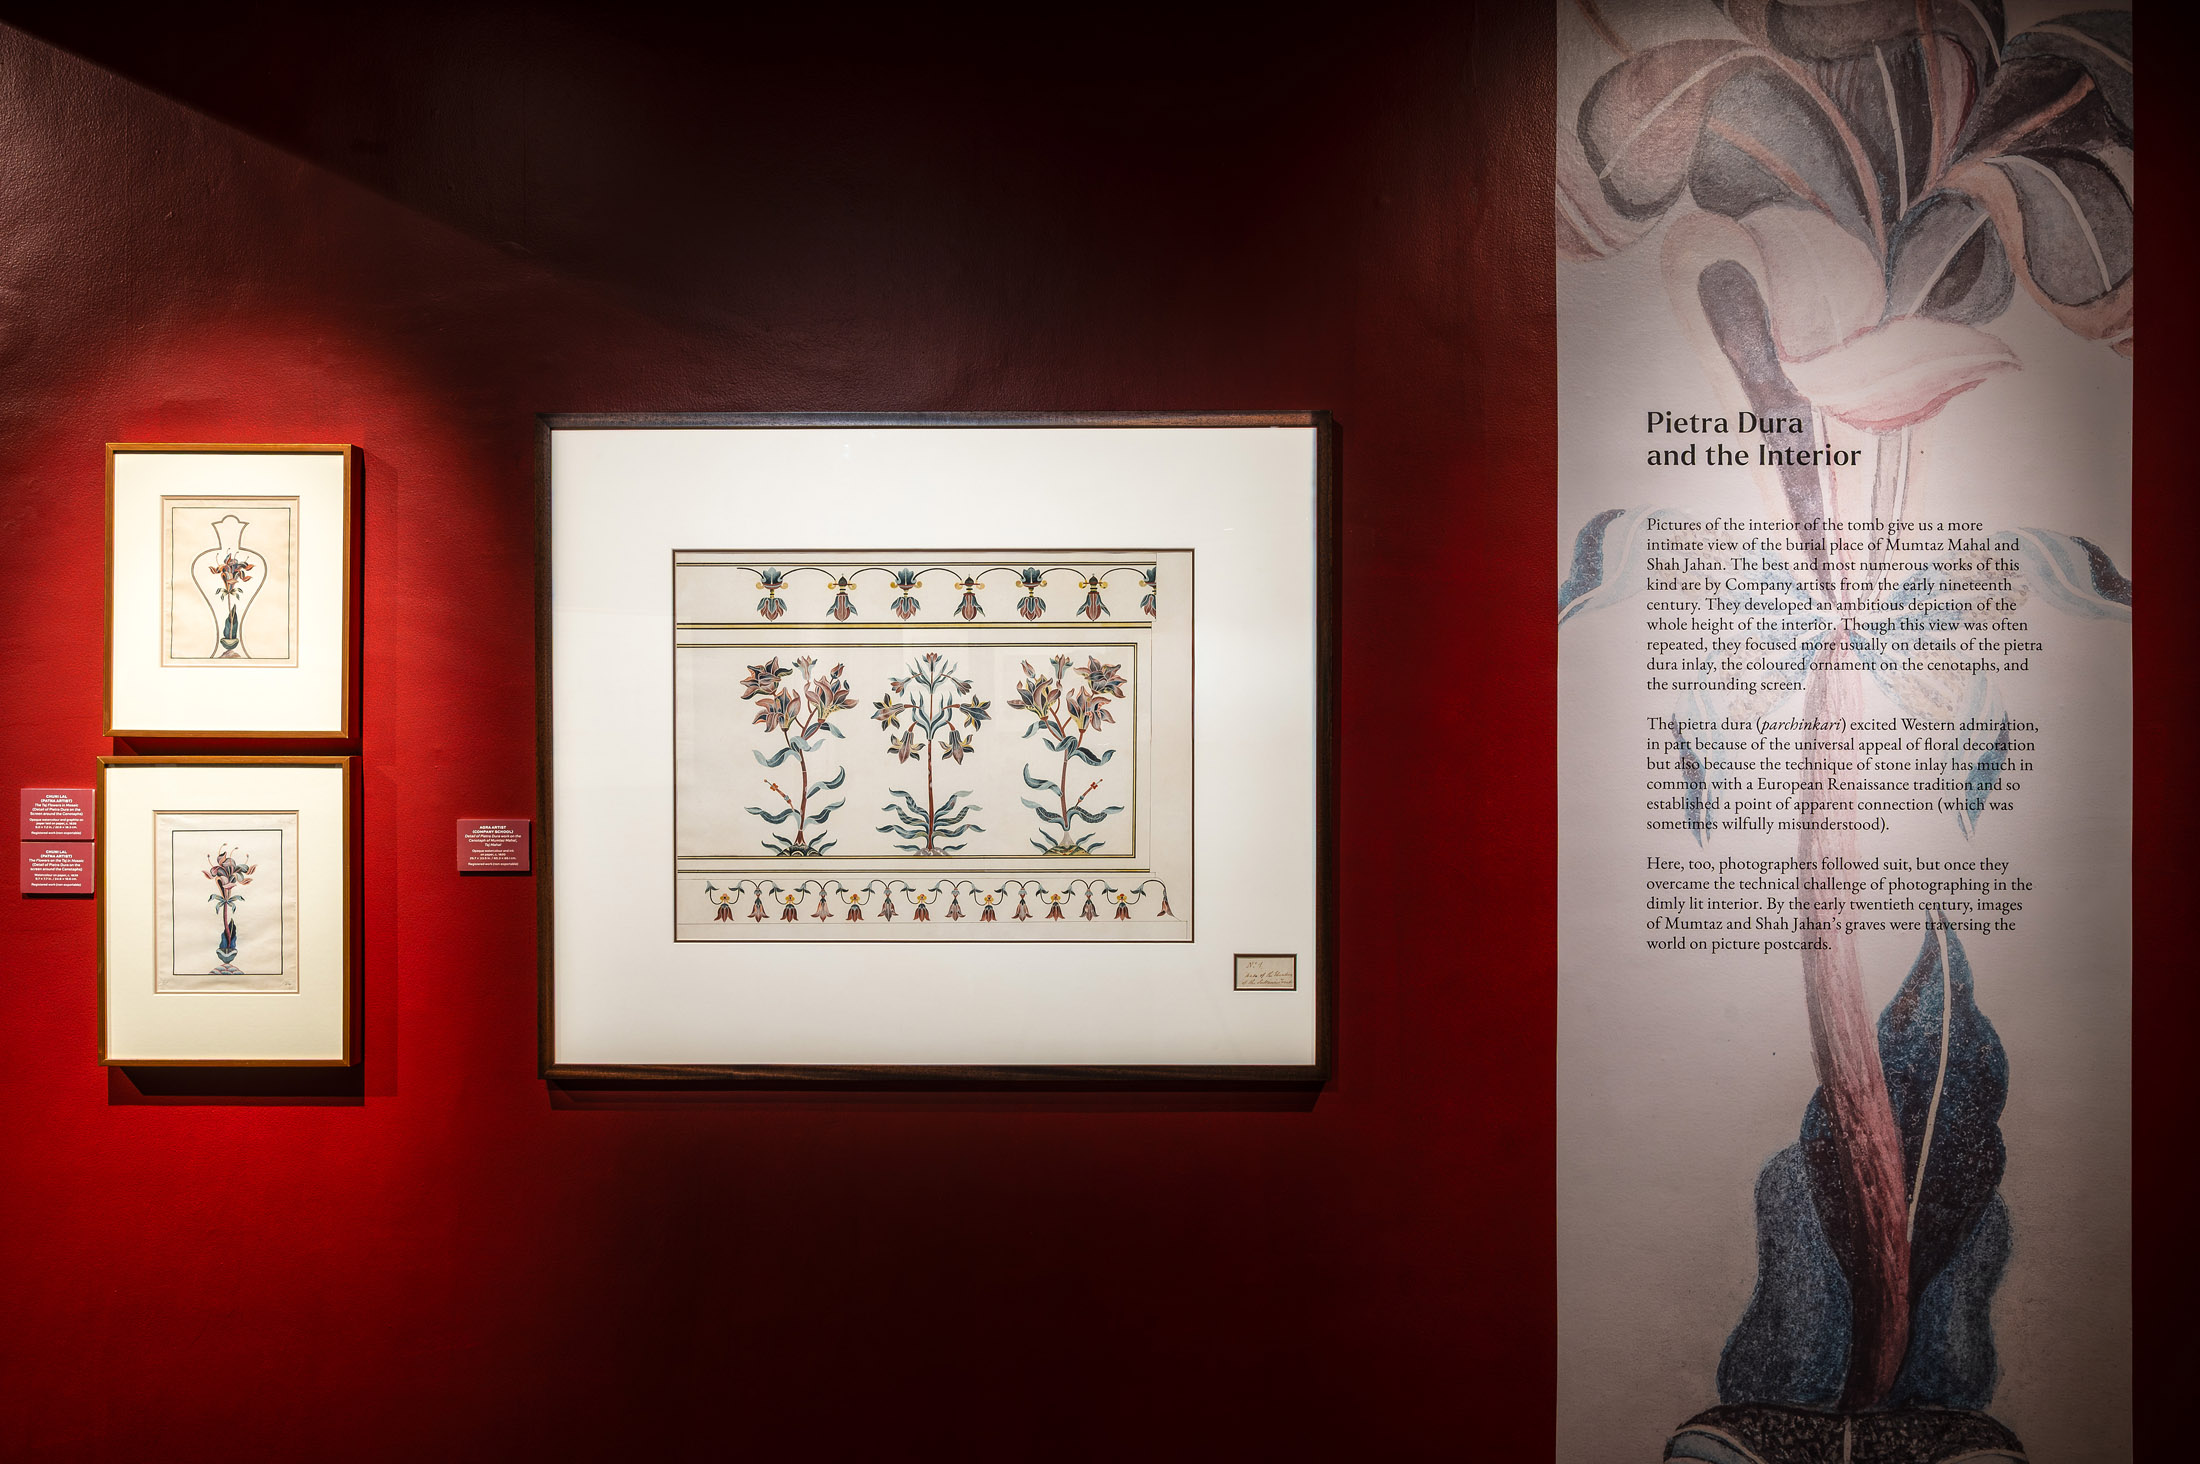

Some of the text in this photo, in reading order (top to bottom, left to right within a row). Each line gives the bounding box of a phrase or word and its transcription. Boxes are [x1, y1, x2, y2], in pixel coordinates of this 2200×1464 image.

[1648, 411, 1804, 434] Pietra Dura
[1647, 443, 1861, 466] and the Interior
[1647, 517, 1982, 534] Pictures of the interior of the tomb give us a more
[1647, 537, 2019, 554] intimate view of the burial place of Mumtaz Mahal and
[1647, 557, 2019, 574] Shah Jahan. The best and most numerous works of this
[1647, 578, 2012, 595] kind are by Company artists from the early nineteenth
[1647, 597, 2016, 614] century. They developed an ambitious depiction of the
[1647, 617, 2027, 634] whole height of the interior. Though this view was often
[1647, 637, 2042, 654] repeated, they focused more usually on details of the pietra
[1647, 657, 2028, 674] dura inlay, the coloured ornament on the cenotaphs, and
[1647, 677, 1805, 694] the surrounding screen.
[1647, 717, 2038, 734] The pietra dura (parchinkari) excited Western admiration,
[1647, 797, 2013, 814] established a point of apparent connection (which was
[1647, 817, 1889, 834] sometimes wilfully misunderstood).
[1647, 857, 2009, 874] Here, too, photographers followed suit, but once they
[1647, 877, 2032, 894] overcame the technical challenge of photographing in the
[1647, 937, 1831, 954] world on picture postcards.
